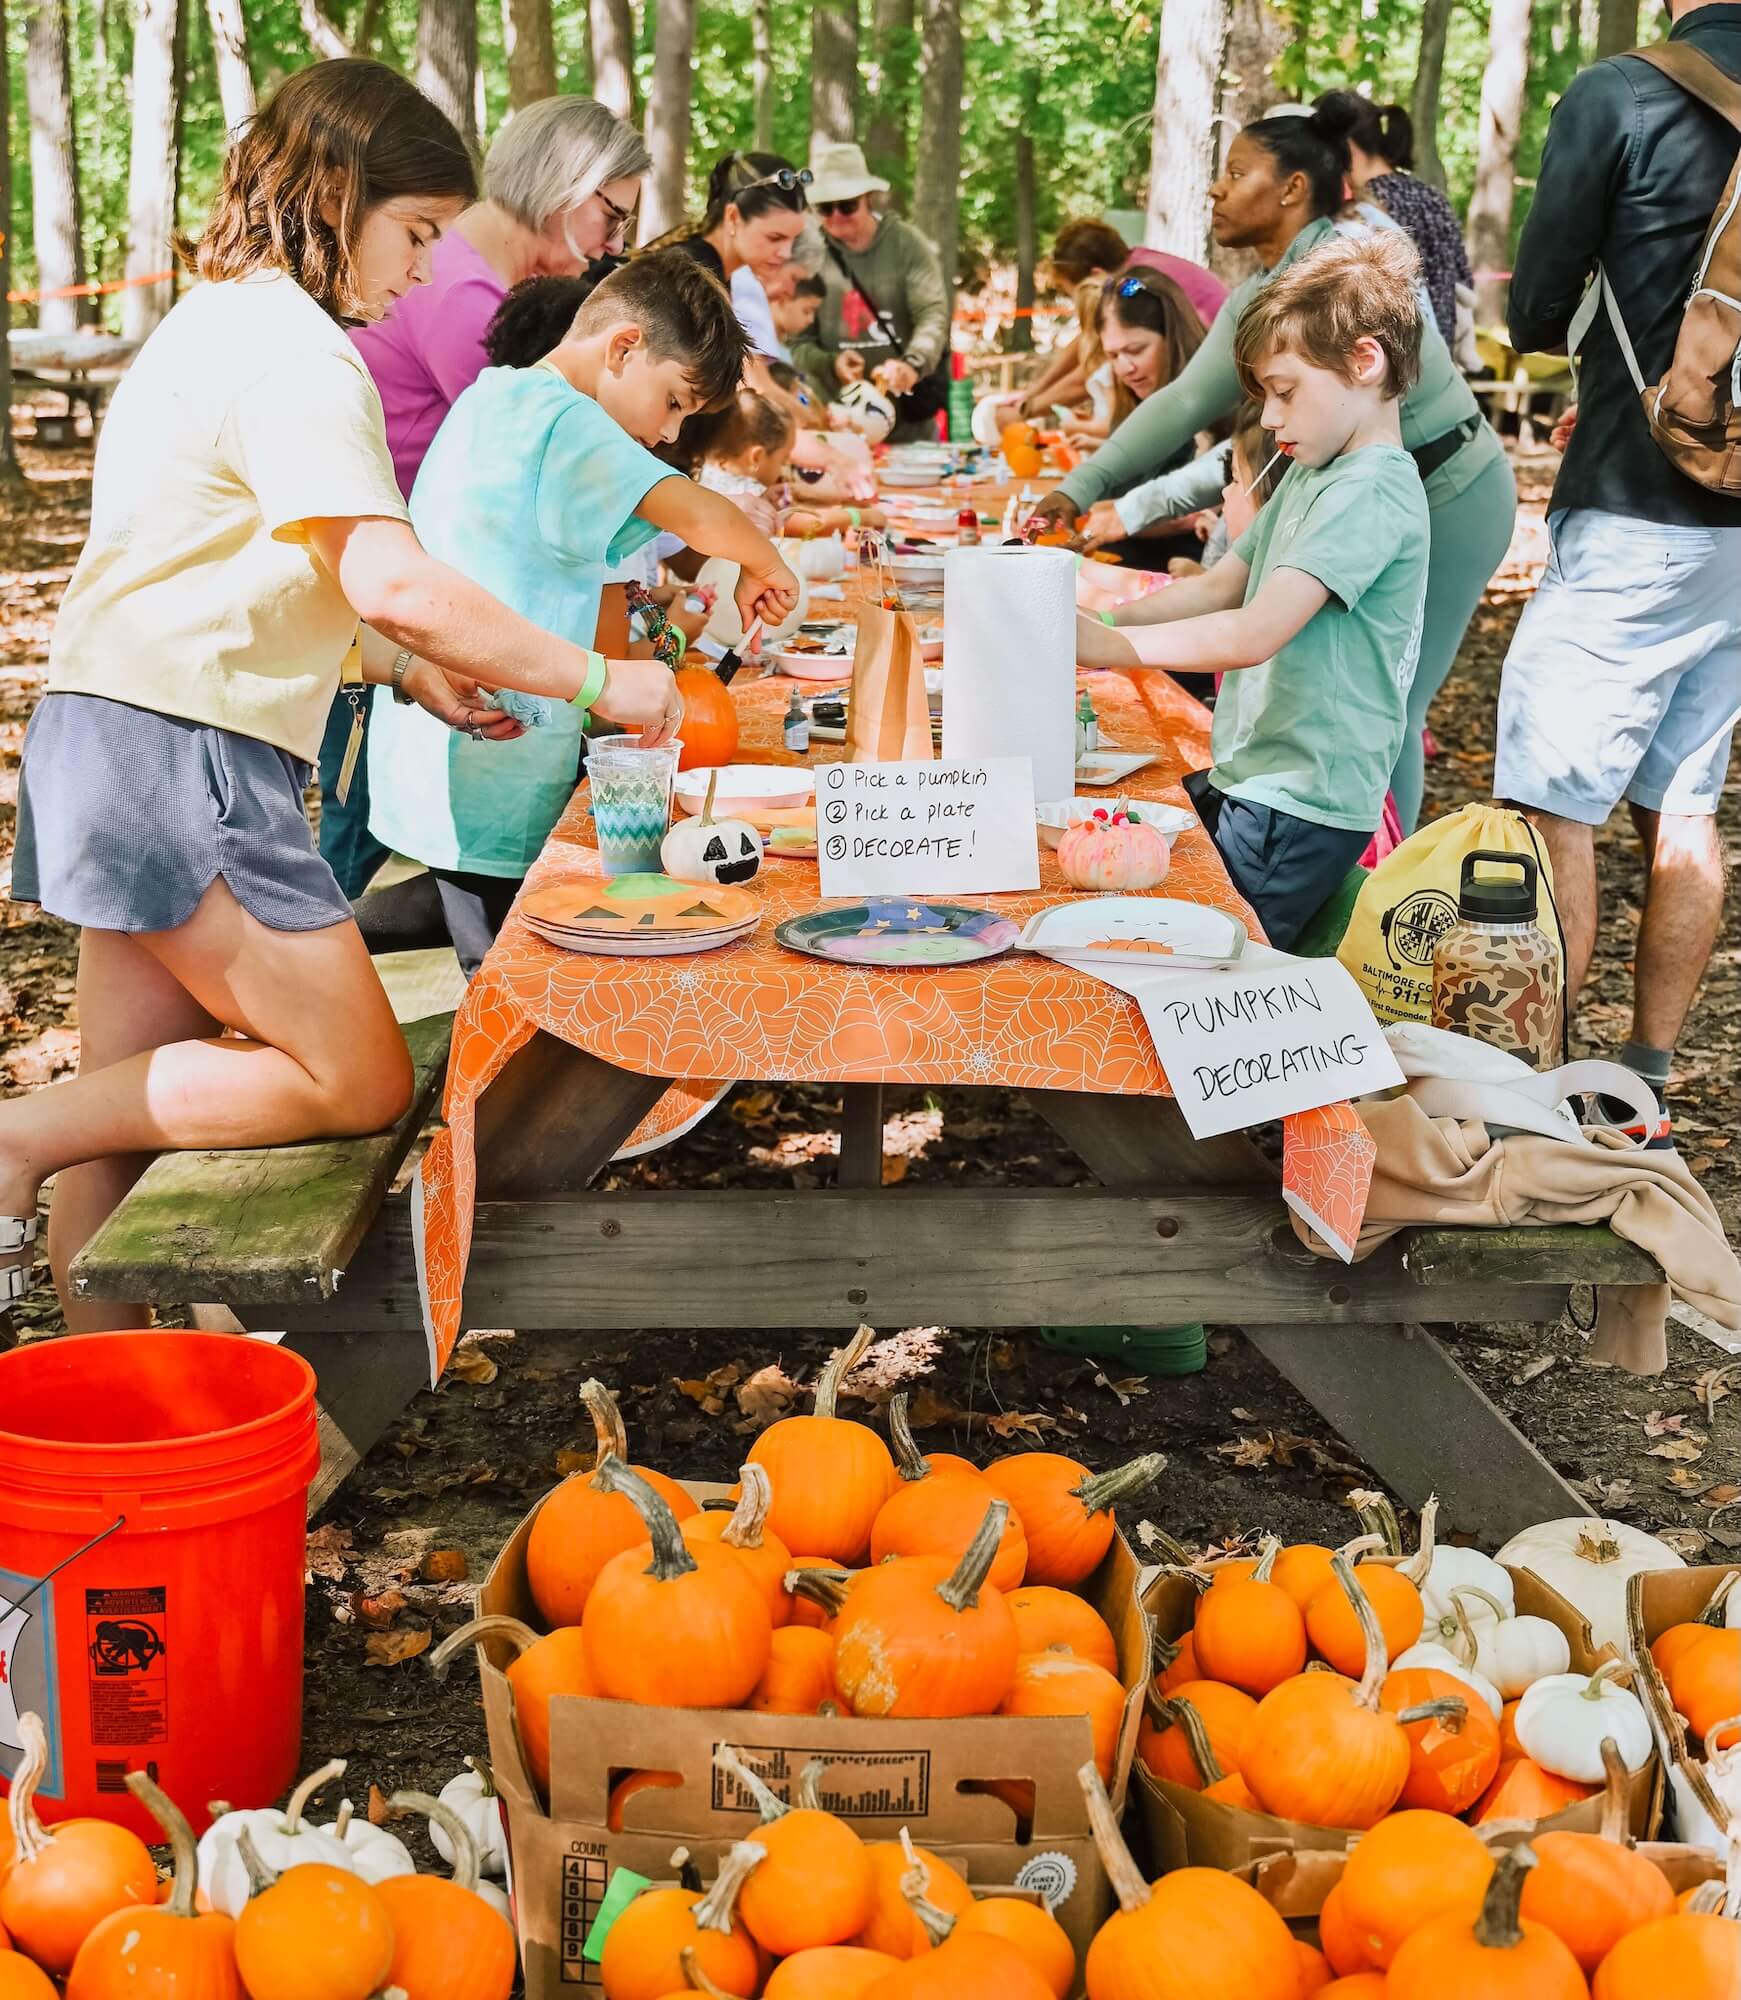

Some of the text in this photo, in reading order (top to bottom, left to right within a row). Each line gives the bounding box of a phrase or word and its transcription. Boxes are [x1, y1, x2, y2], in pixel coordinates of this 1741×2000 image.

[854, 769, 889, 788] Pick
[896, 774, 908, 785] a
[918, 768, 987, 791] pumpkin
[855, 802, 889, 821] Pick
[900, 808, 916, 819] a
[928, 801, 975, 824] plate
[1362, 963, 1433, 993] BALTIMORE CO
[1163, 978, 1322, 1034] PUMPKIN
[1371, 1000, 1428, 1021] First Responder
[1193, 1034, 1369, 1101] DECORATING
[571, 1841, 608, 1857] COUNT
[569, 1862, 579, 1875] 4
[568, 1942, 578, 1957] 9
